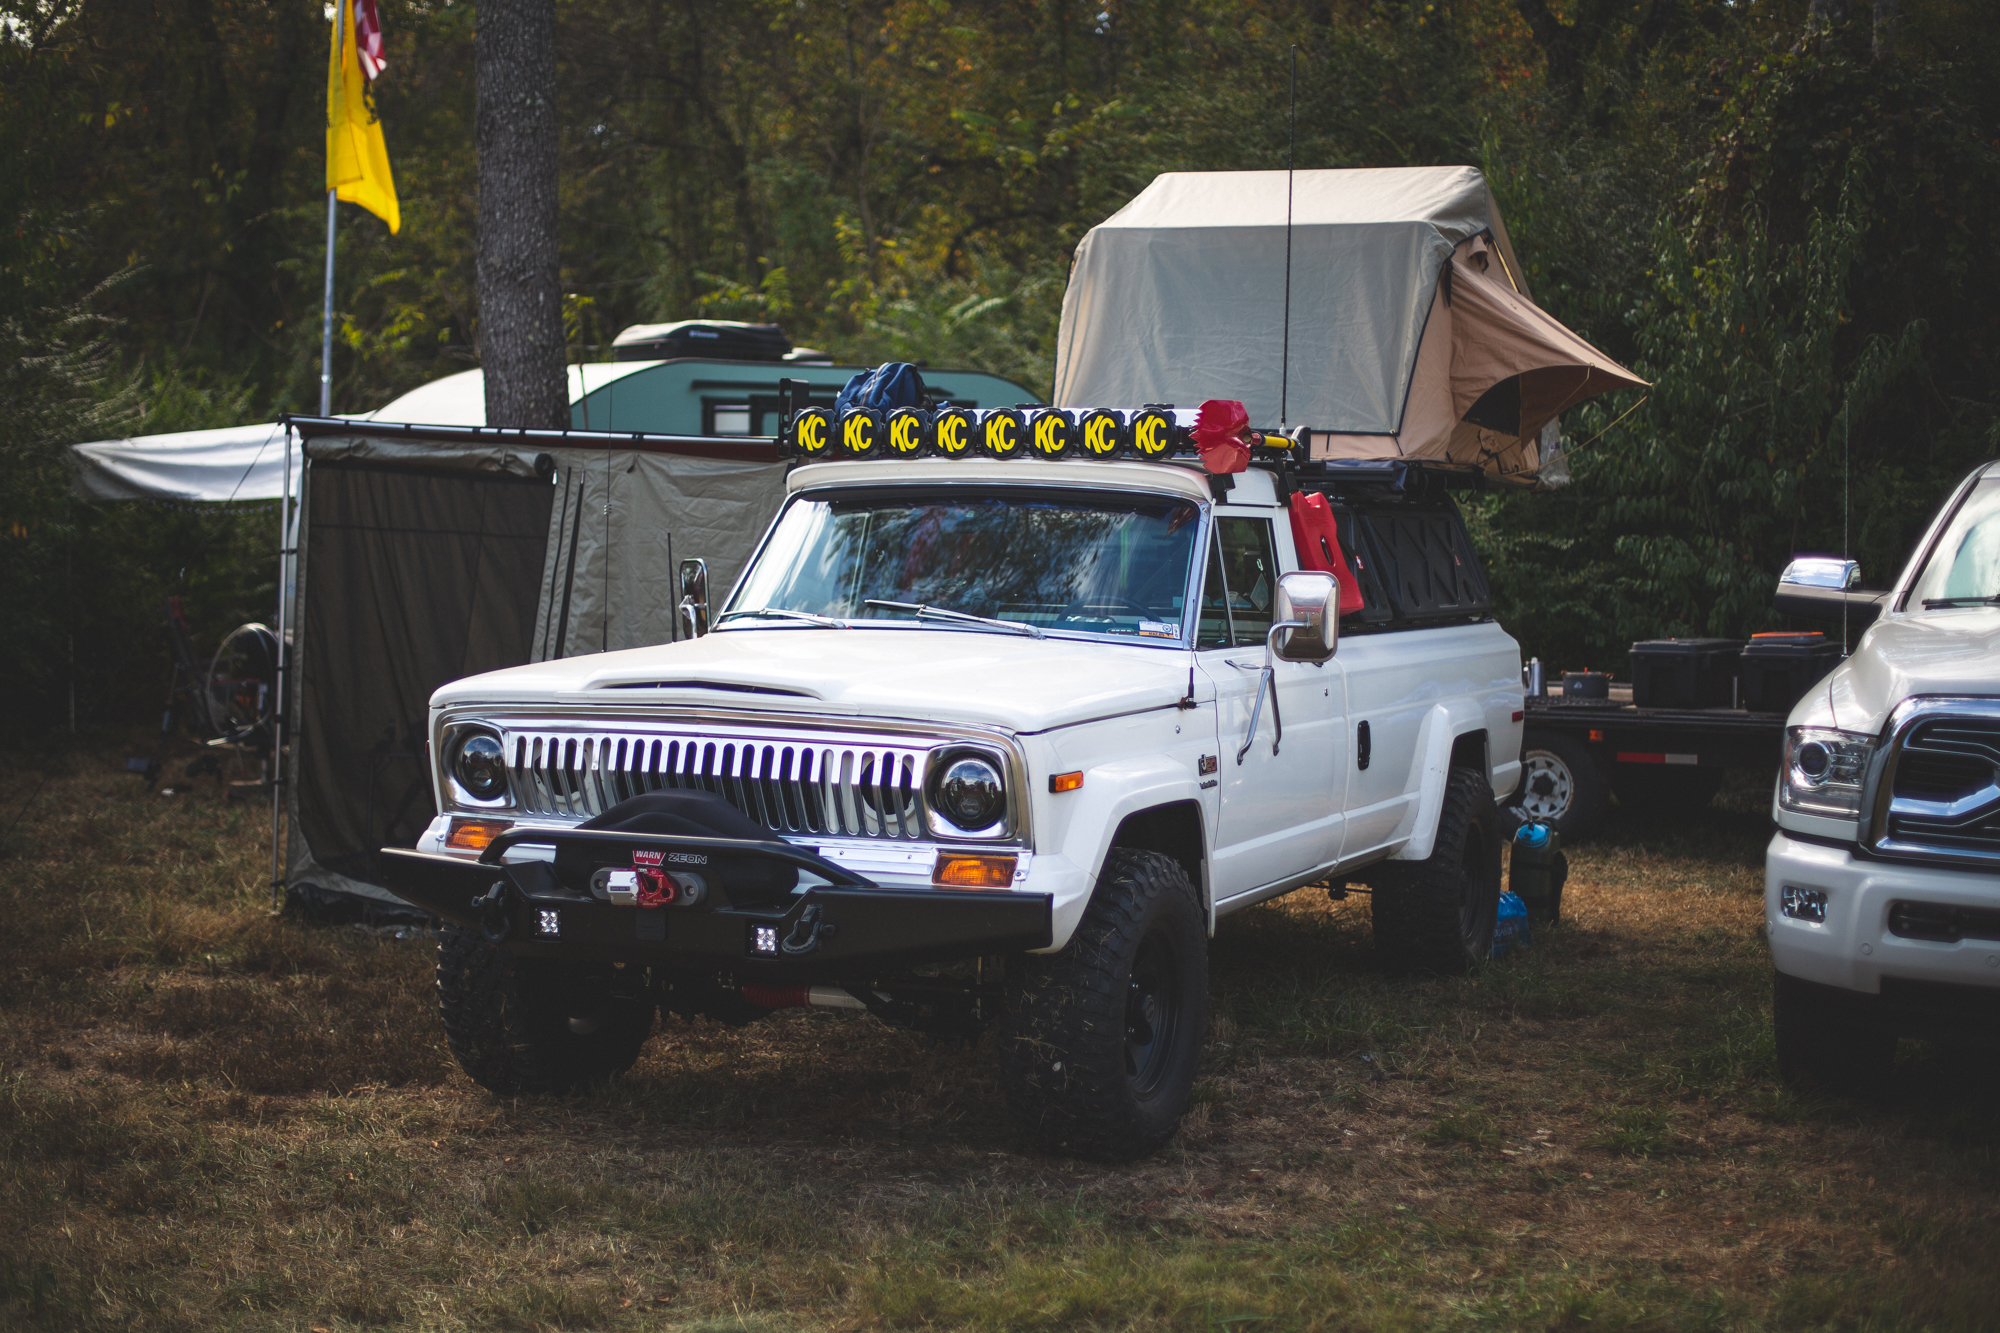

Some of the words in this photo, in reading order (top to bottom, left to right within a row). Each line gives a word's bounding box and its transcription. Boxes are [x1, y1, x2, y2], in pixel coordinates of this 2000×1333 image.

[798, 415, 826, 452] KC
[843, 415, 872, 452] KC
[890, 415, 919, 452] KC
[938, 415, 966, 452] KC
[985, 415, 1015, 453] KC
[1035, 415, 1065, 453] KC
[1085, 415, 1115, 453] KC
[1136, 415, 1166, 453] KC
[1201, 754, 1217, 772] J20
[635, 850, 662, 860] WARN
[668, 852, 708, 865] ZEON
